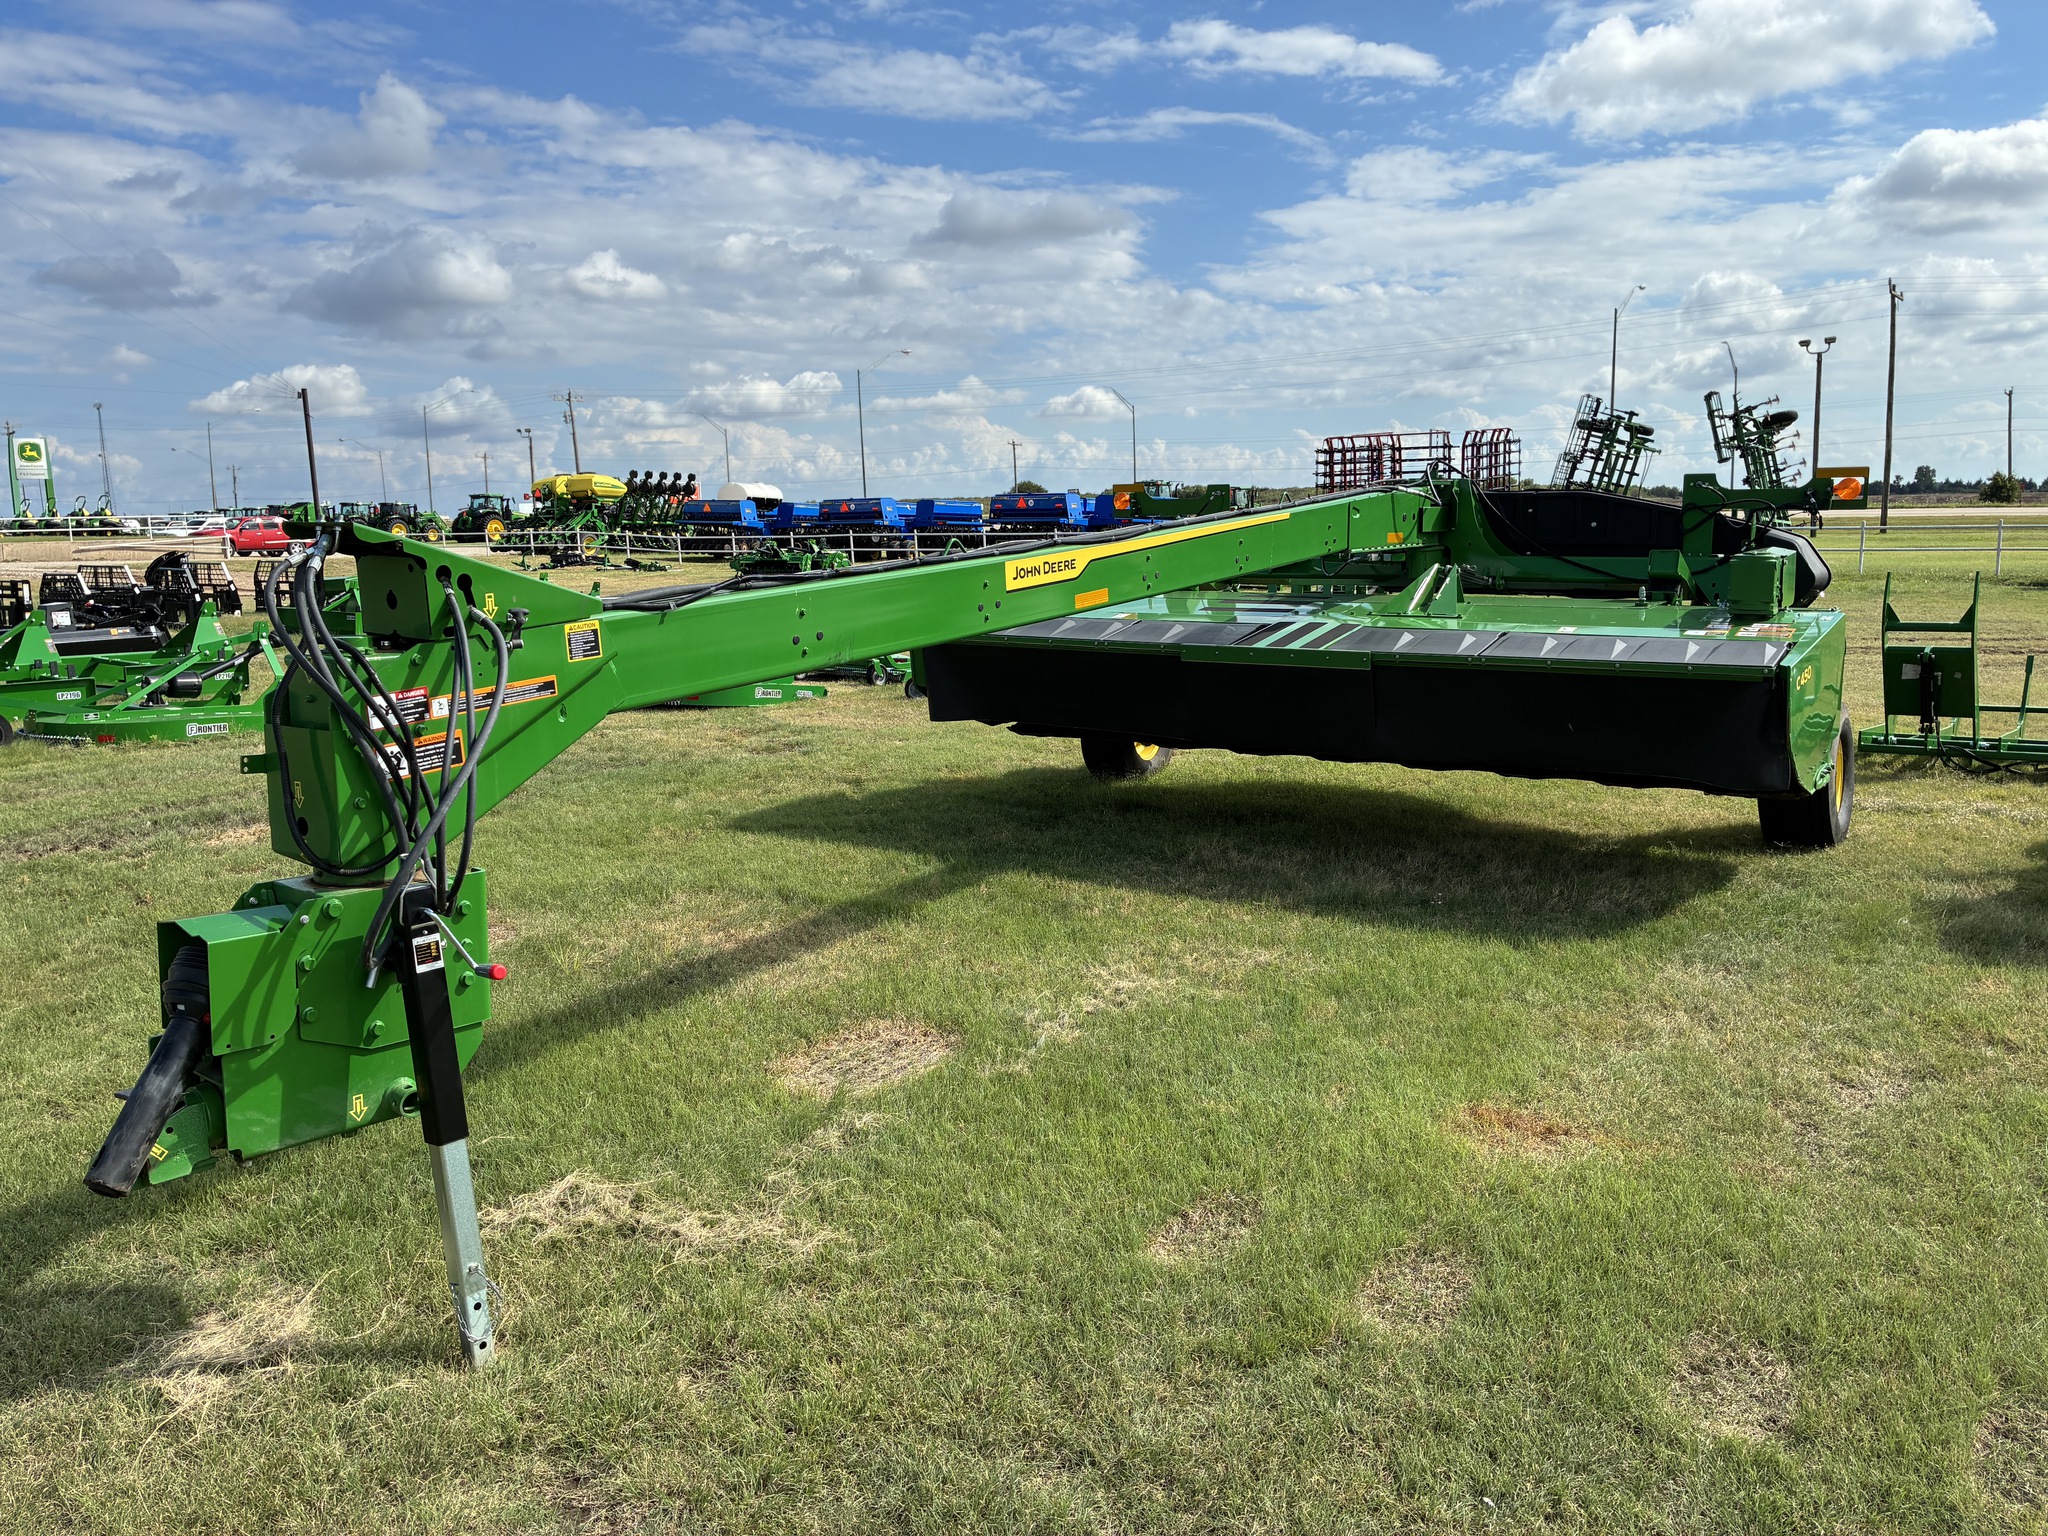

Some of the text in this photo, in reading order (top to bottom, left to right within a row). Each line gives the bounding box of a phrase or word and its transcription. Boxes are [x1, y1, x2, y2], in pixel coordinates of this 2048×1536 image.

[1012, 559, 1076, 580] JOHN DEERE
[573, 622, 596, 631] CAUTION
[403, 688, 425, 698] DANGER
[188, 724, 228, 736] FRONTIER
